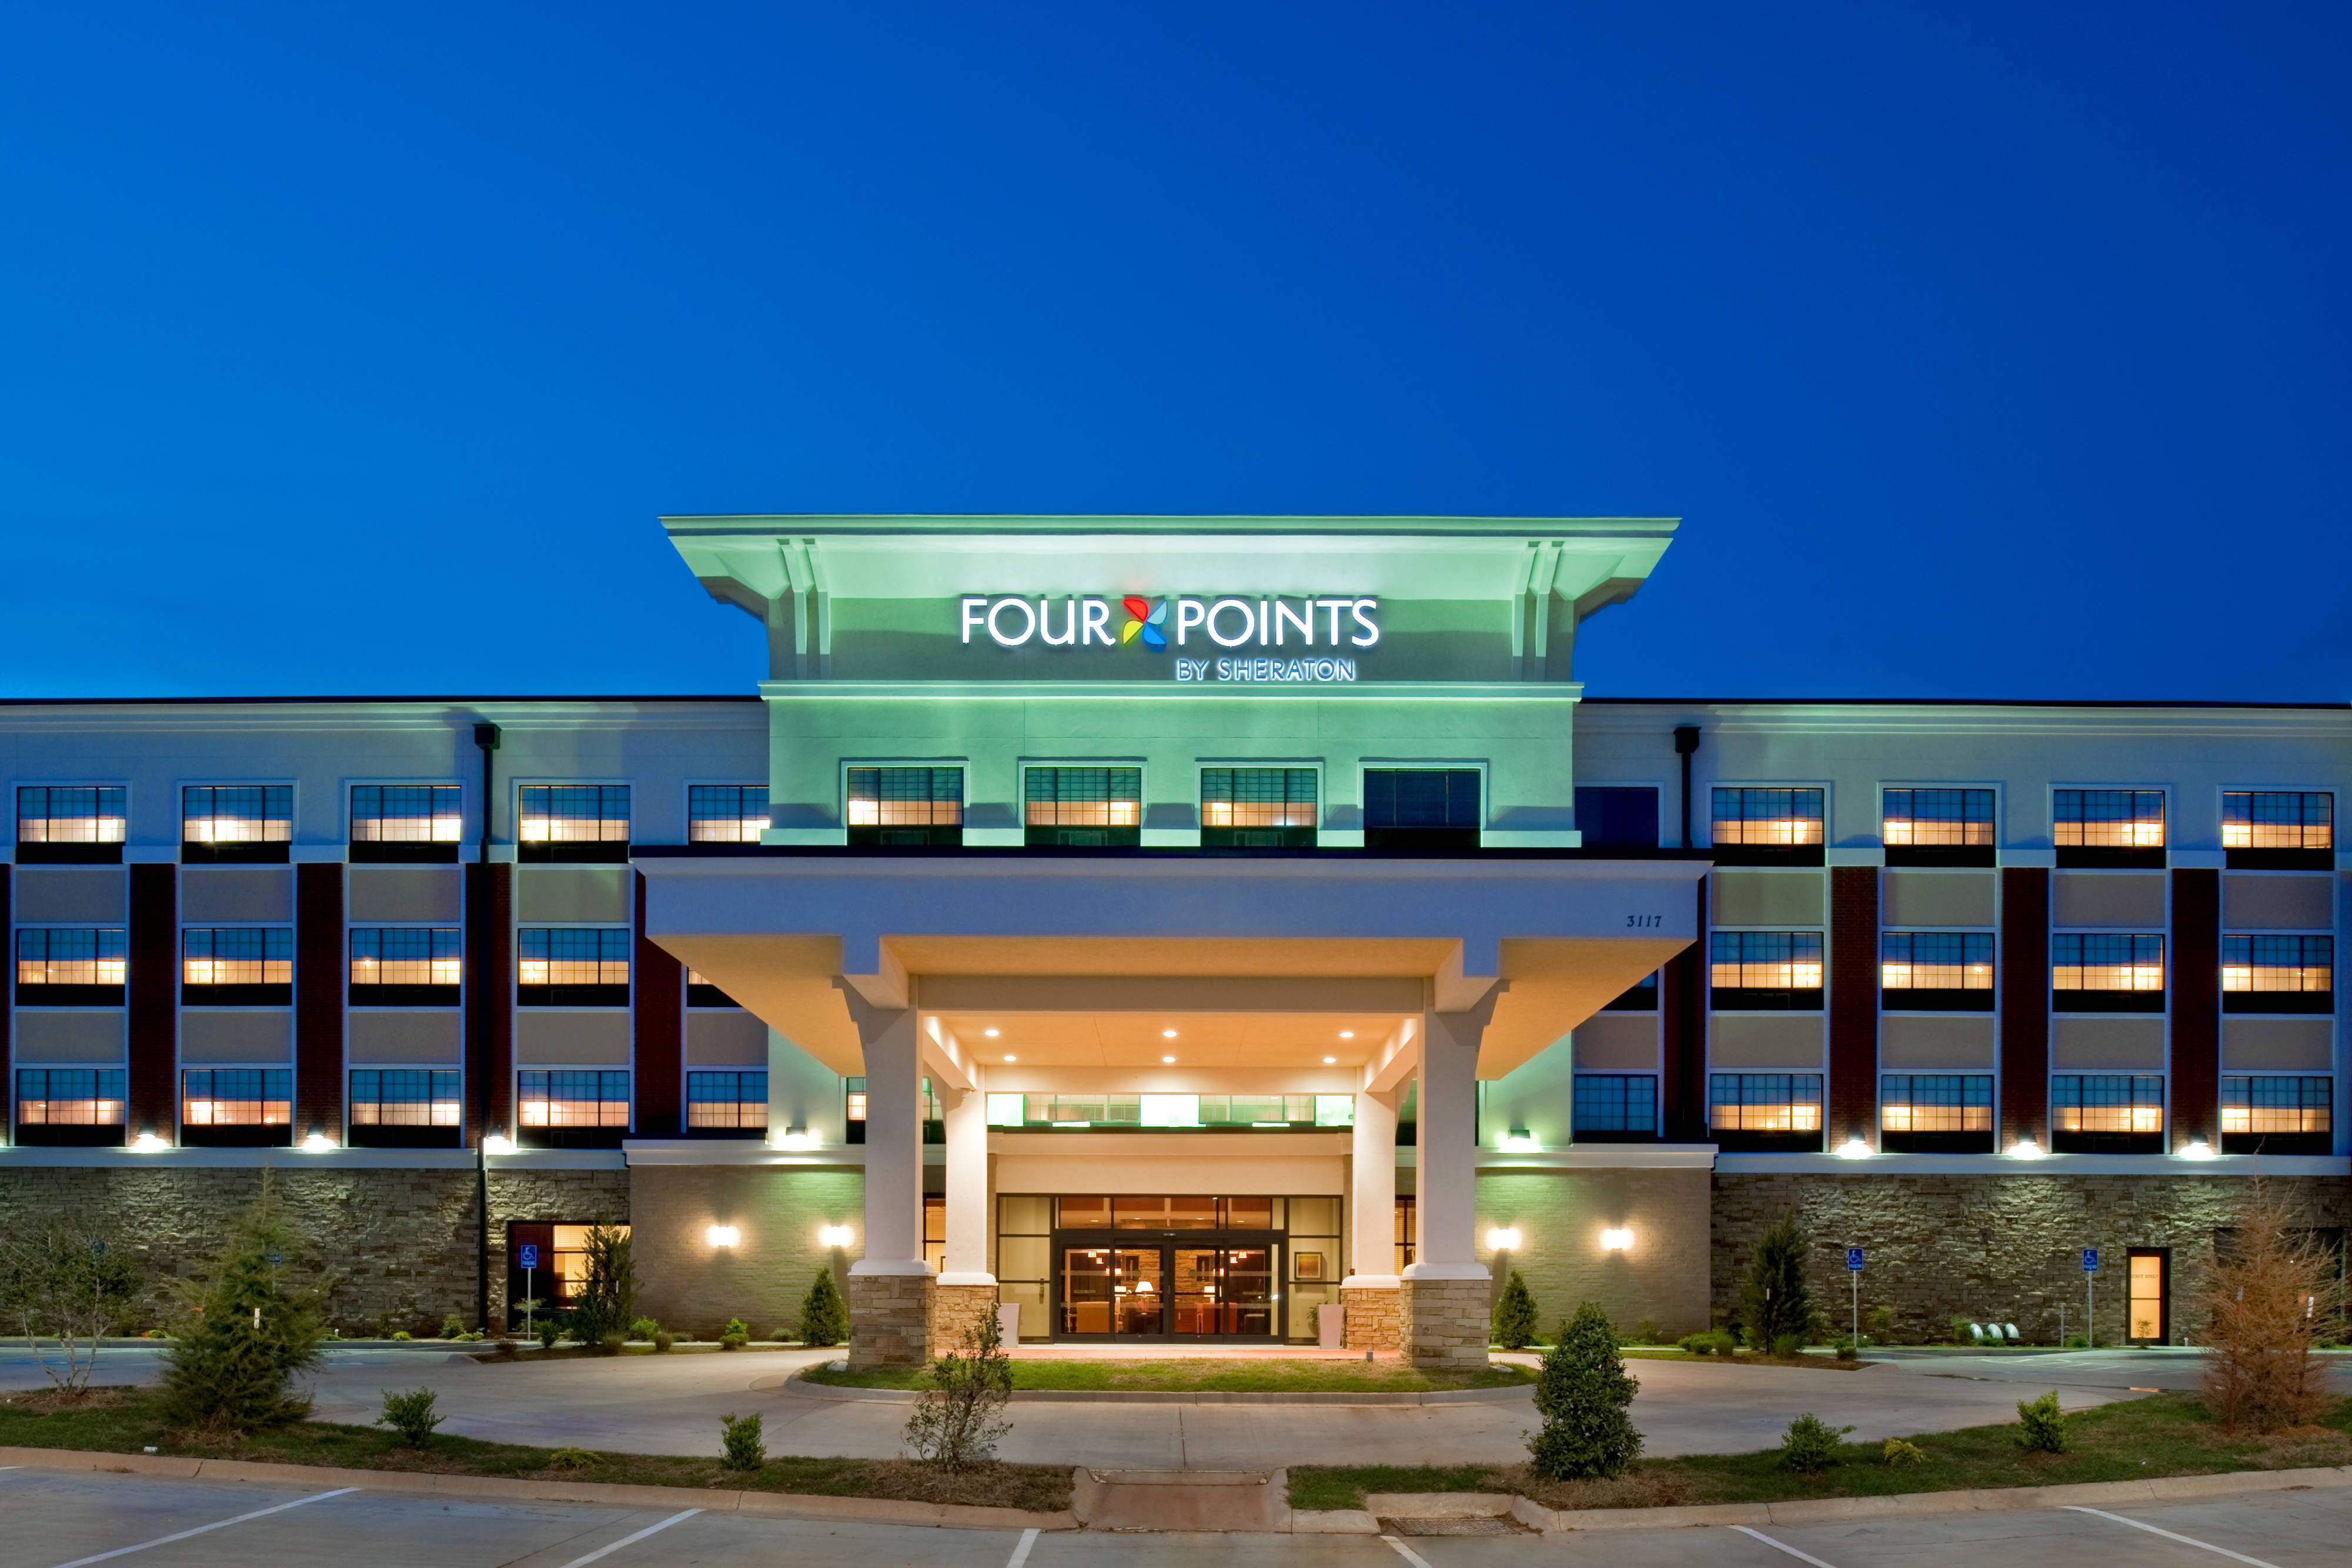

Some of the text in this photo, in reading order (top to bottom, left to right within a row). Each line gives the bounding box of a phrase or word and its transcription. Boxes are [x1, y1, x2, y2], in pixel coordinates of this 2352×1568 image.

[962, 599, 1379, 646] FOUR POINTS
[1178, 660, 1355, 681] BY SHERATON
[1626, 915, 1662, 928] 3117
